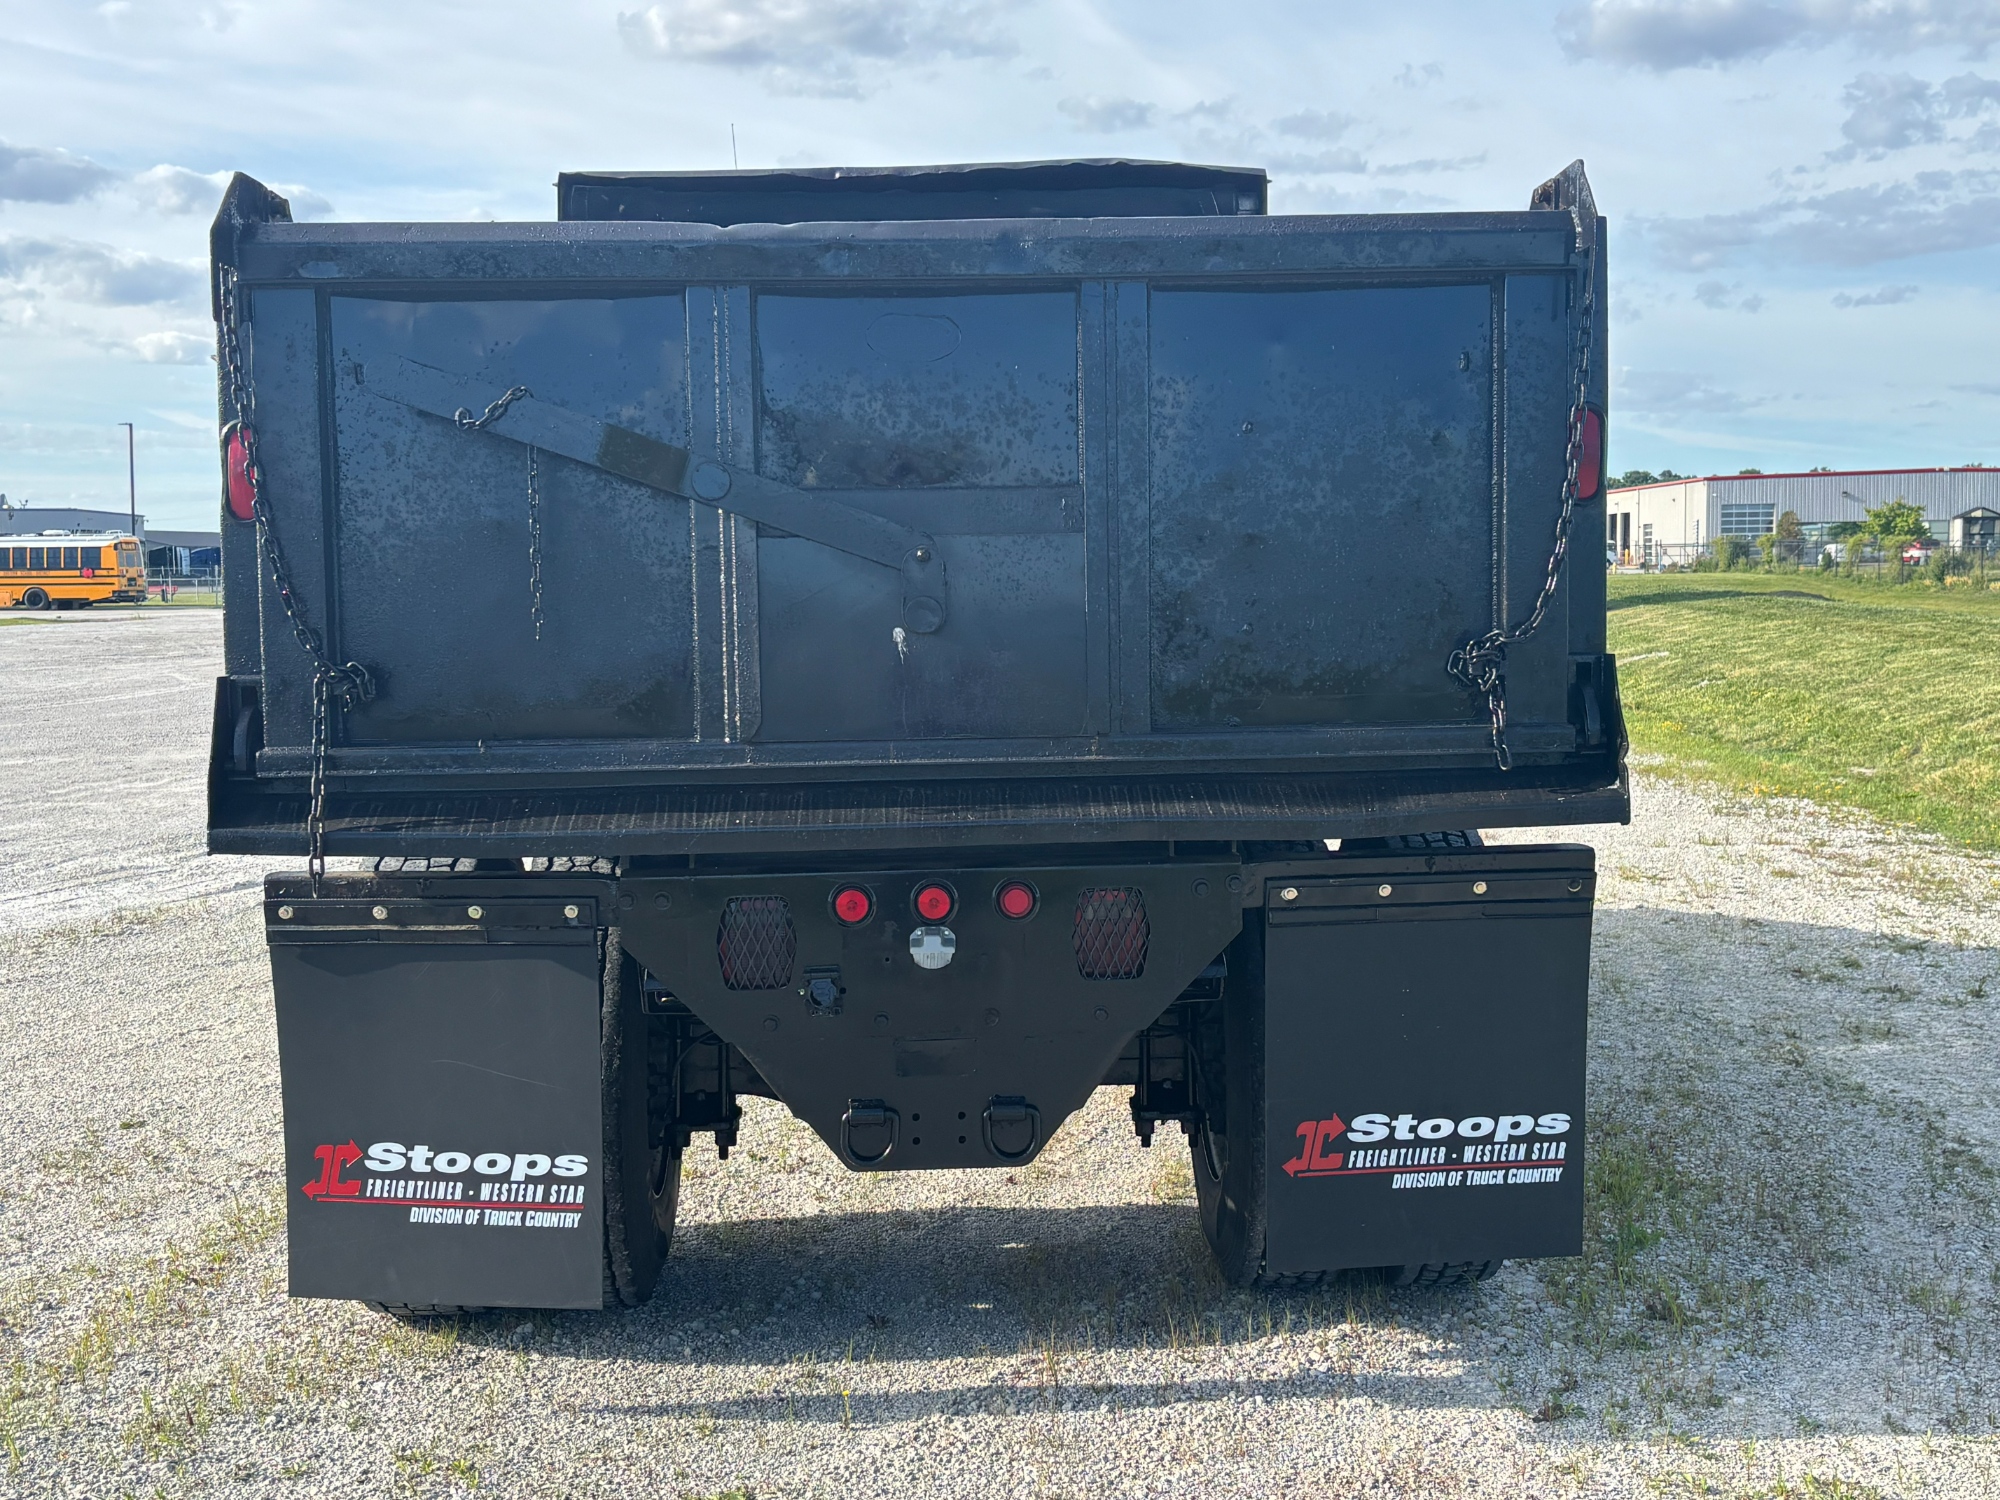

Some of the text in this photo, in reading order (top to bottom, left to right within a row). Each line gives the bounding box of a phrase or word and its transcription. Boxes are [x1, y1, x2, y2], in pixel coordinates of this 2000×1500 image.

[1346, 1113, 1571, 1143] Stoops
[364, 1142, 589, 1181] Stoops
[1348, 1142, 1567, 1168] FREIGHTLINER WESTERN STAR
[365, 1178, 585, 1204] FREIGHTLINER WESTERN STAR
[1392, 1167, 1563, 1189] DIVISION OF TRUCK COUNTRY
[409, 1206, 582, 1228] DIVISION OF TRUCK COUNTRY
